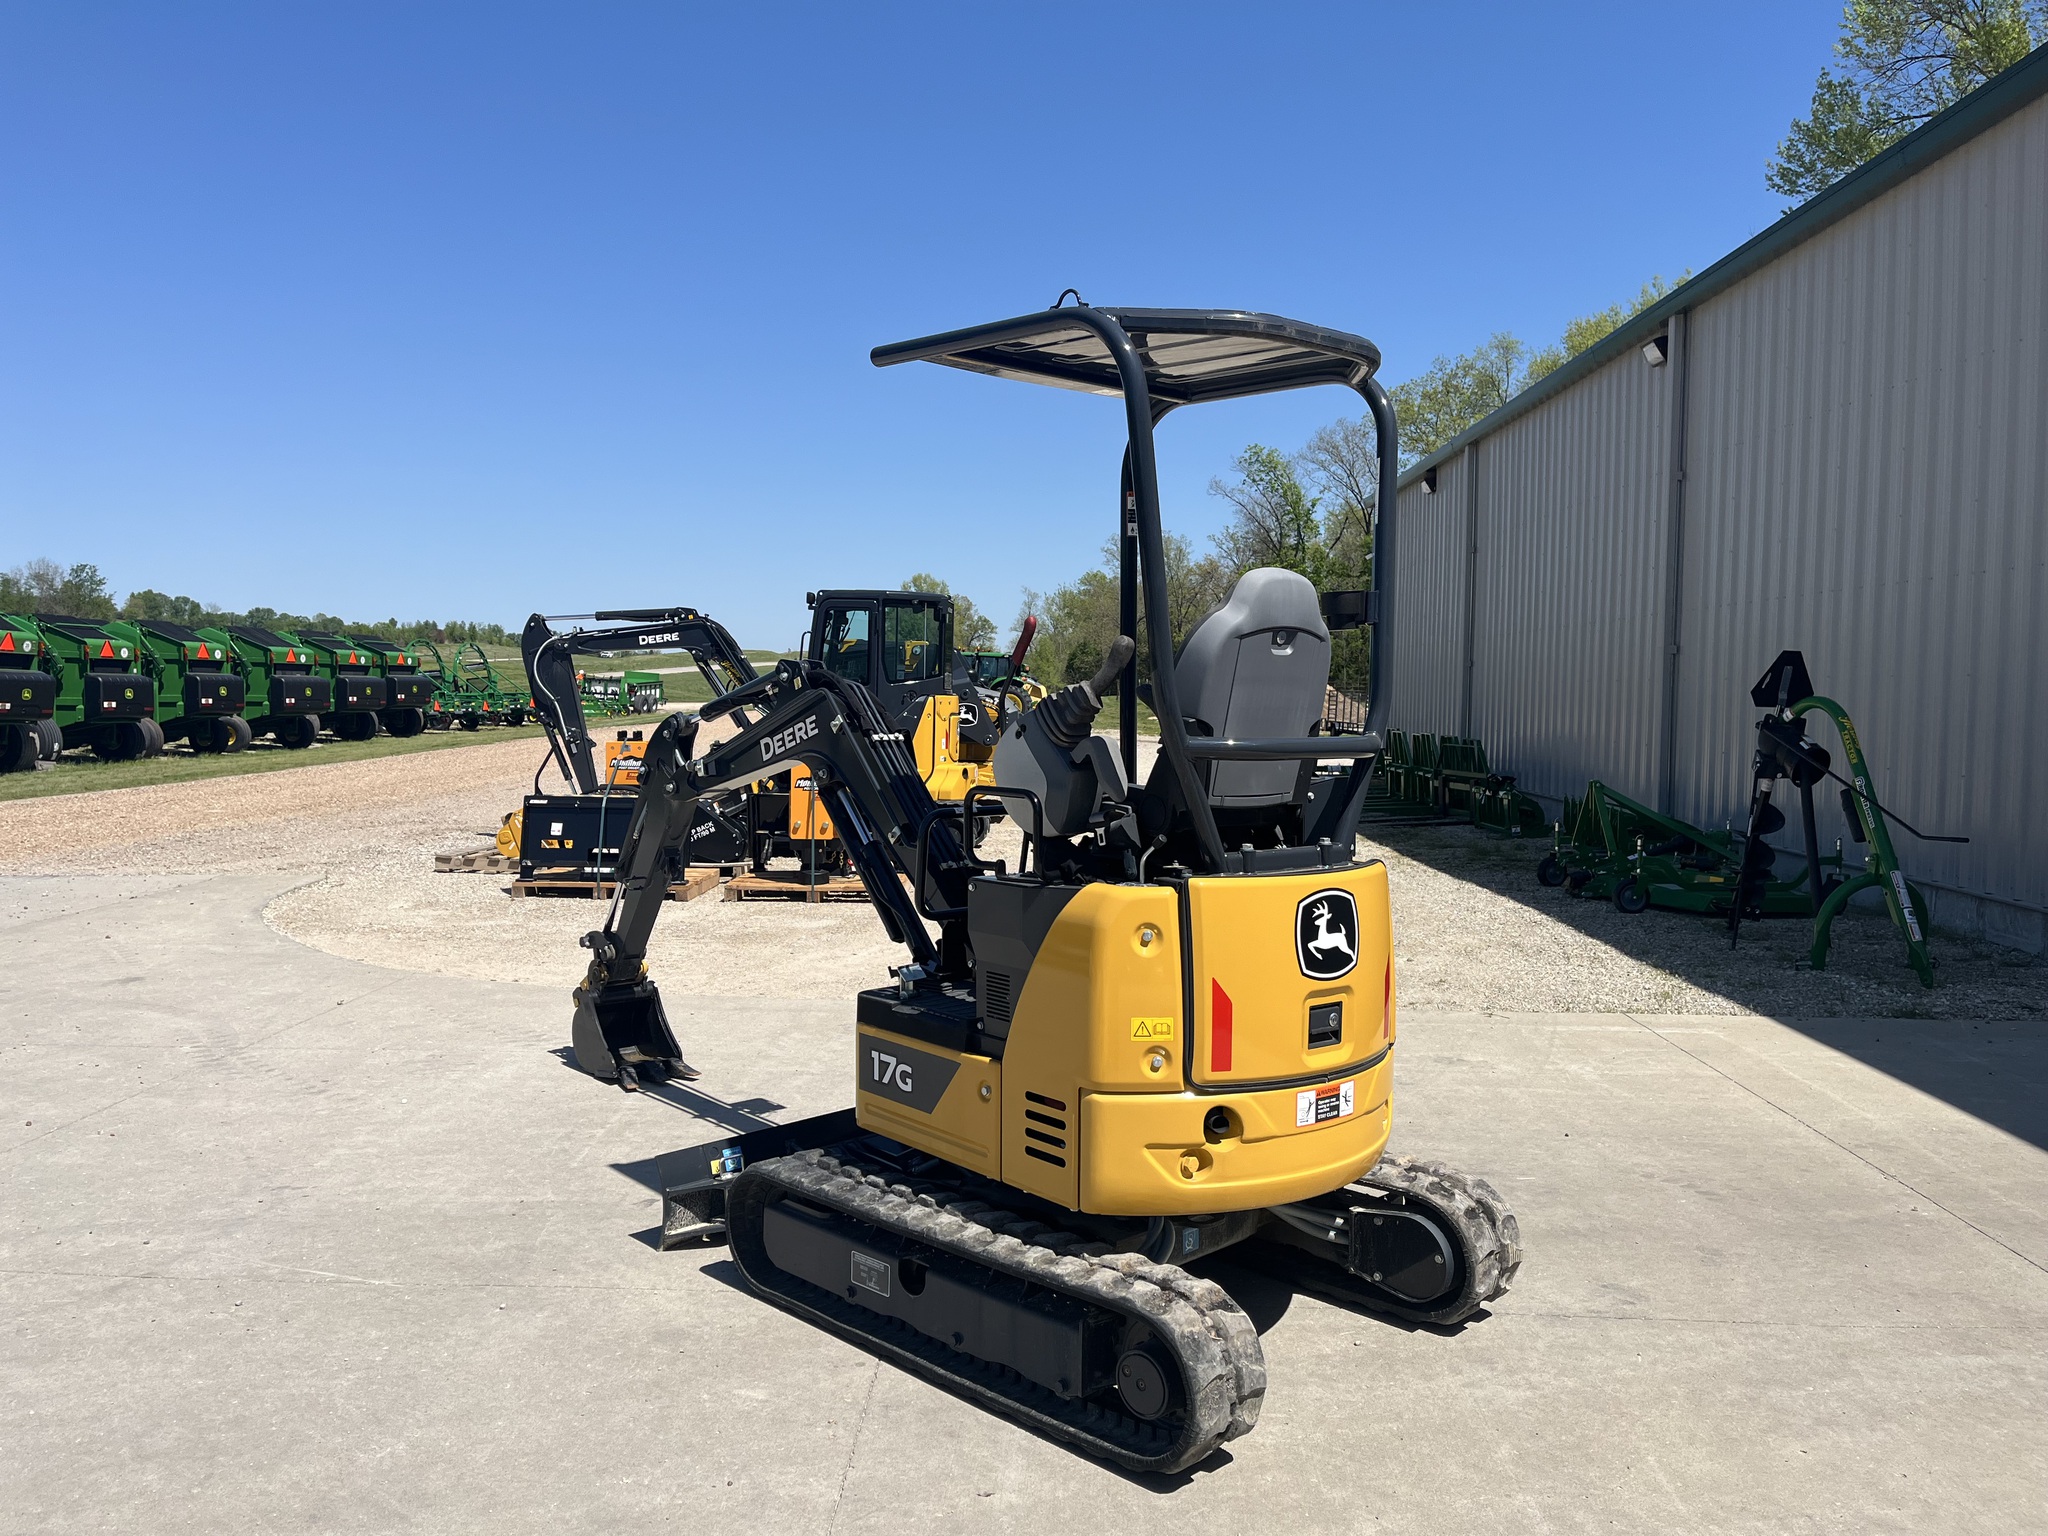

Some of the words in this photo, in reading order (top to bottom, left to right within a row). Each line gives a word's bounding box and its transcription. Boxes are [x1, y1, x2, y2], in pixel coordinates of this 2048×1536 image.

[638, 632, 680, 646] DEERE
[760, 714, 819, 762] DEERE
[696, 820, 715, 834] BACK
[709, 826, 716, 834] M
[871, 1050, 912, 1092] 17G
